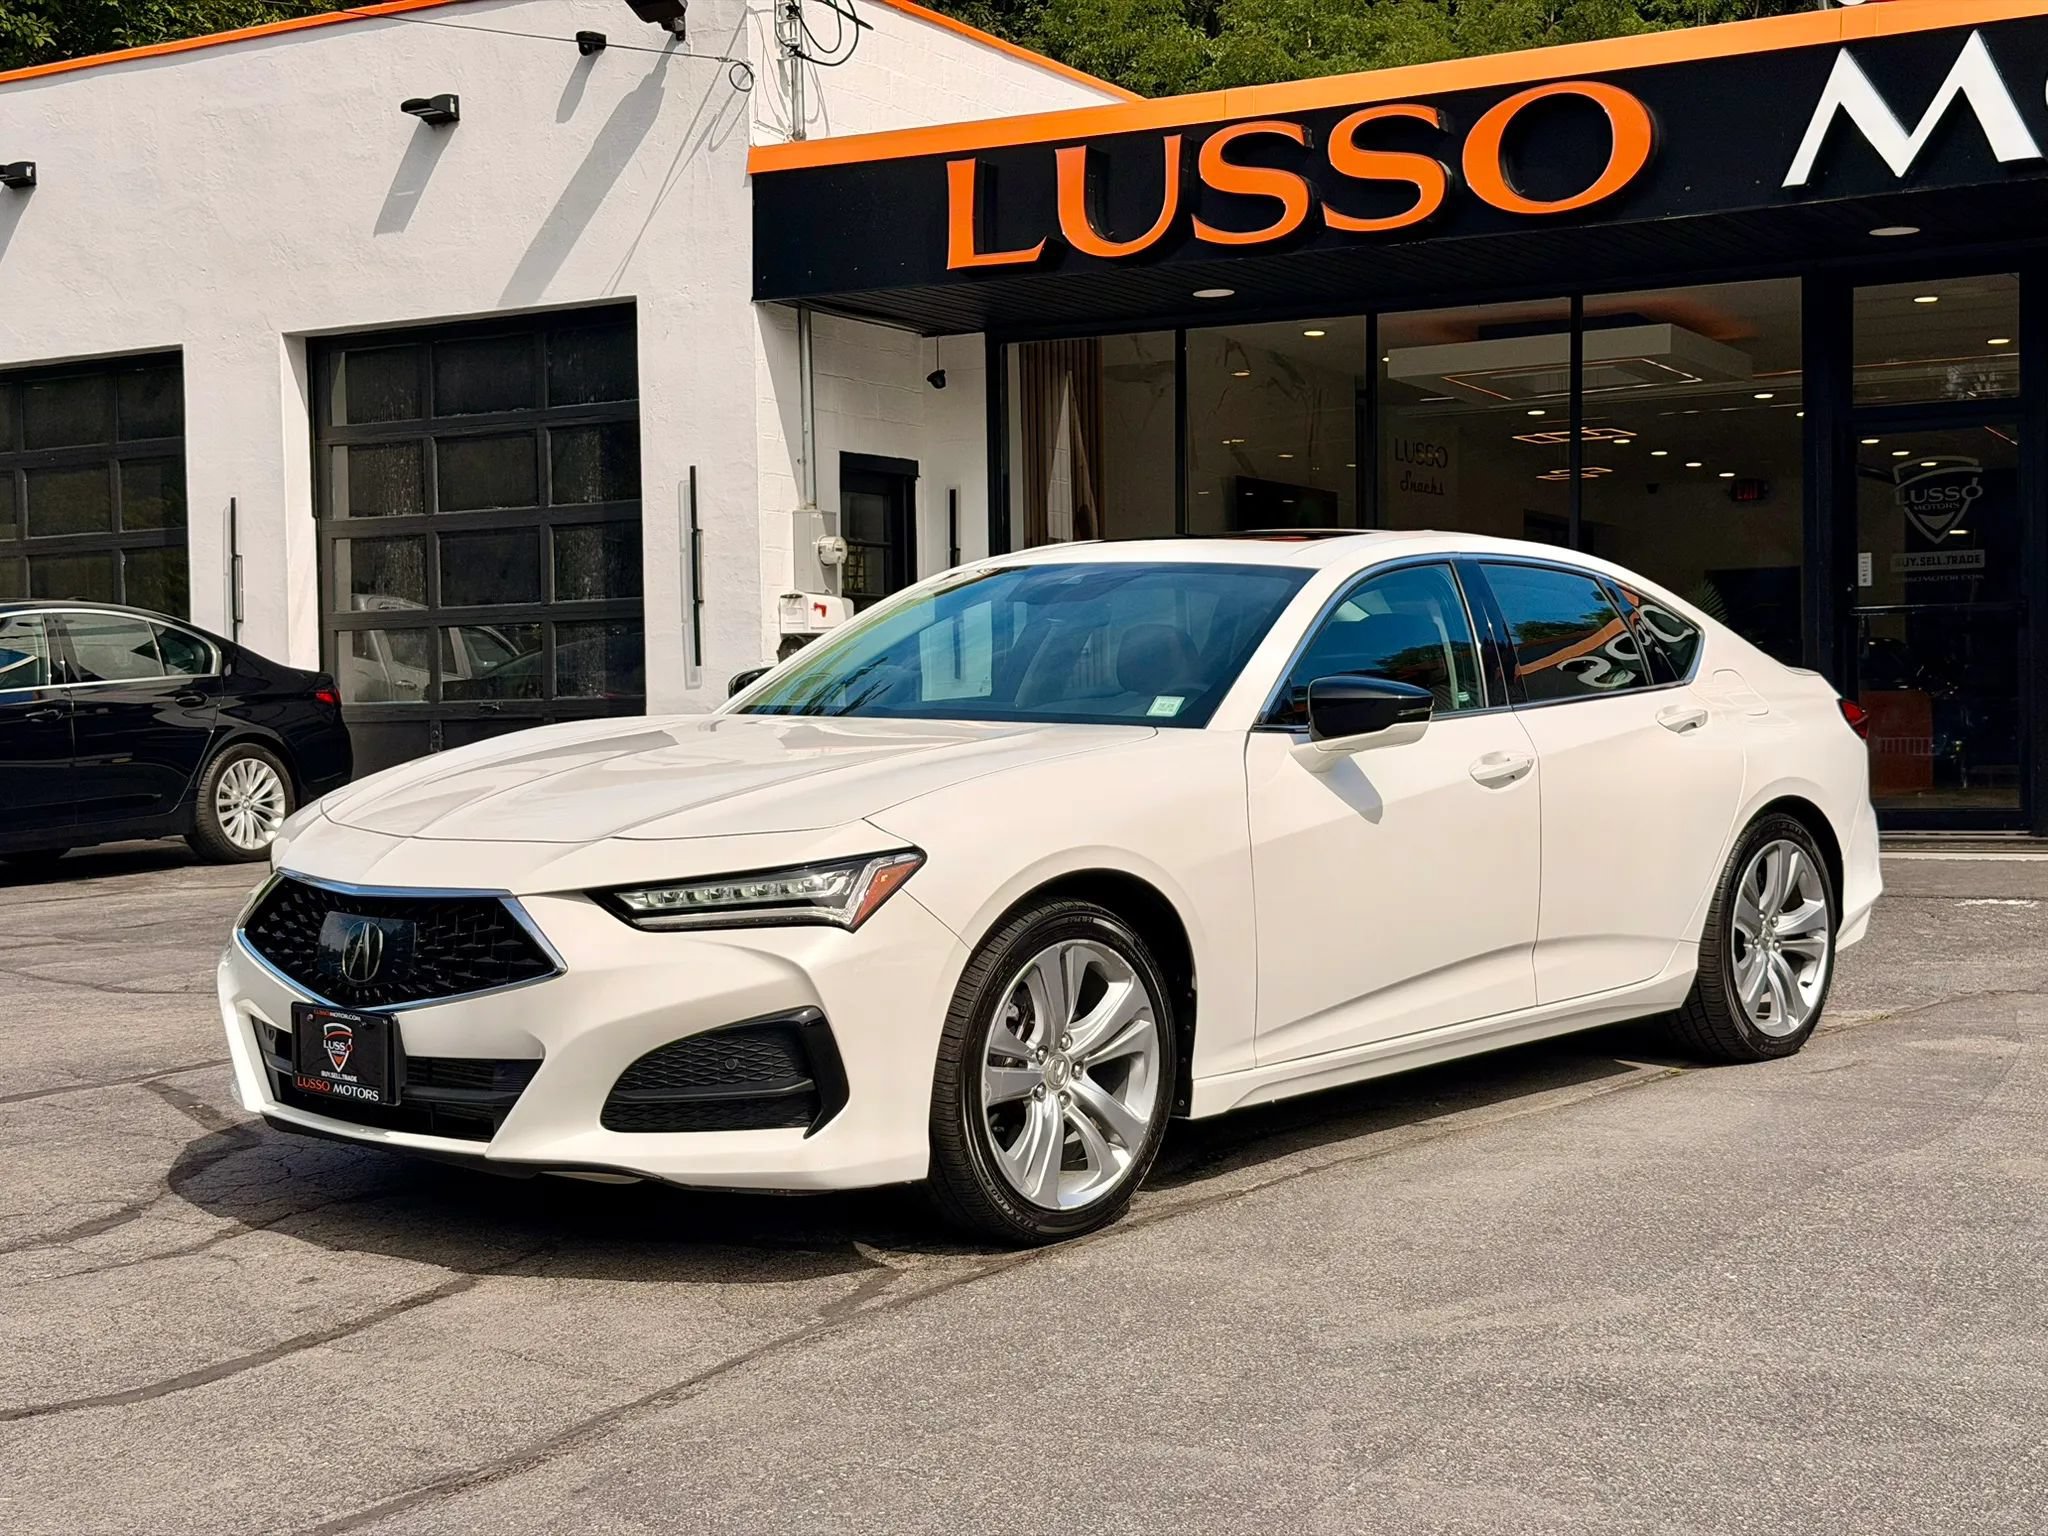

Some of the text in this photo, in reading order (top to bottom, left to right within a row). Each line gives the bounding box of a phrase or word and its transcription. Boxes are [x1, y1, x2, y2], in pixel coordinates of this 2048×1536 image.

[945, 29, 2048, 270] LUSSO M
[297, 1076, 379, 1101] LUSSO MOTORS
